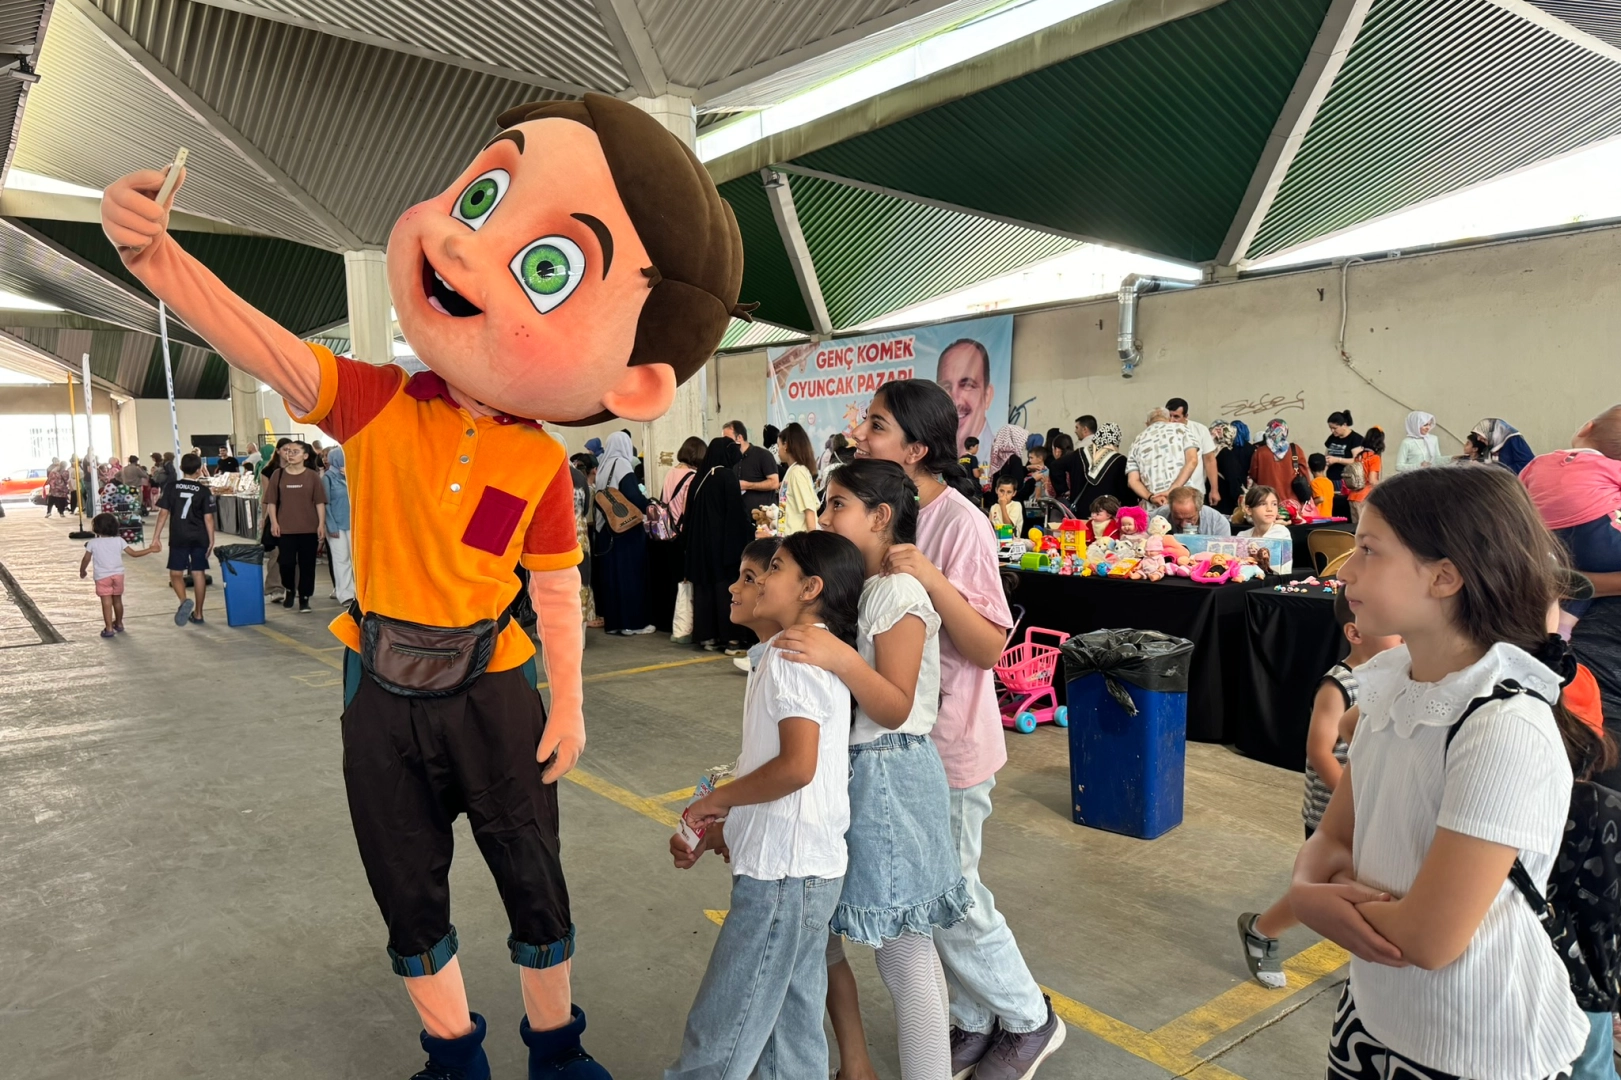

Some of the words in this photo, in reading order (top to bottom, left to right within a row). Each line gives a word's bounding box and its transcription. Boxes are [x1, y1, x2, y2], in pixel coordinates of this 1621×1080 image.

[816, 347, 854, 370] GENÇ
[857, 338, 913, 364] KOMEK
[788, 377, 854, 399] OYUNCAK
[175, 483, 200, 492] RONALDO
[179, 492, 194, 519] 7
